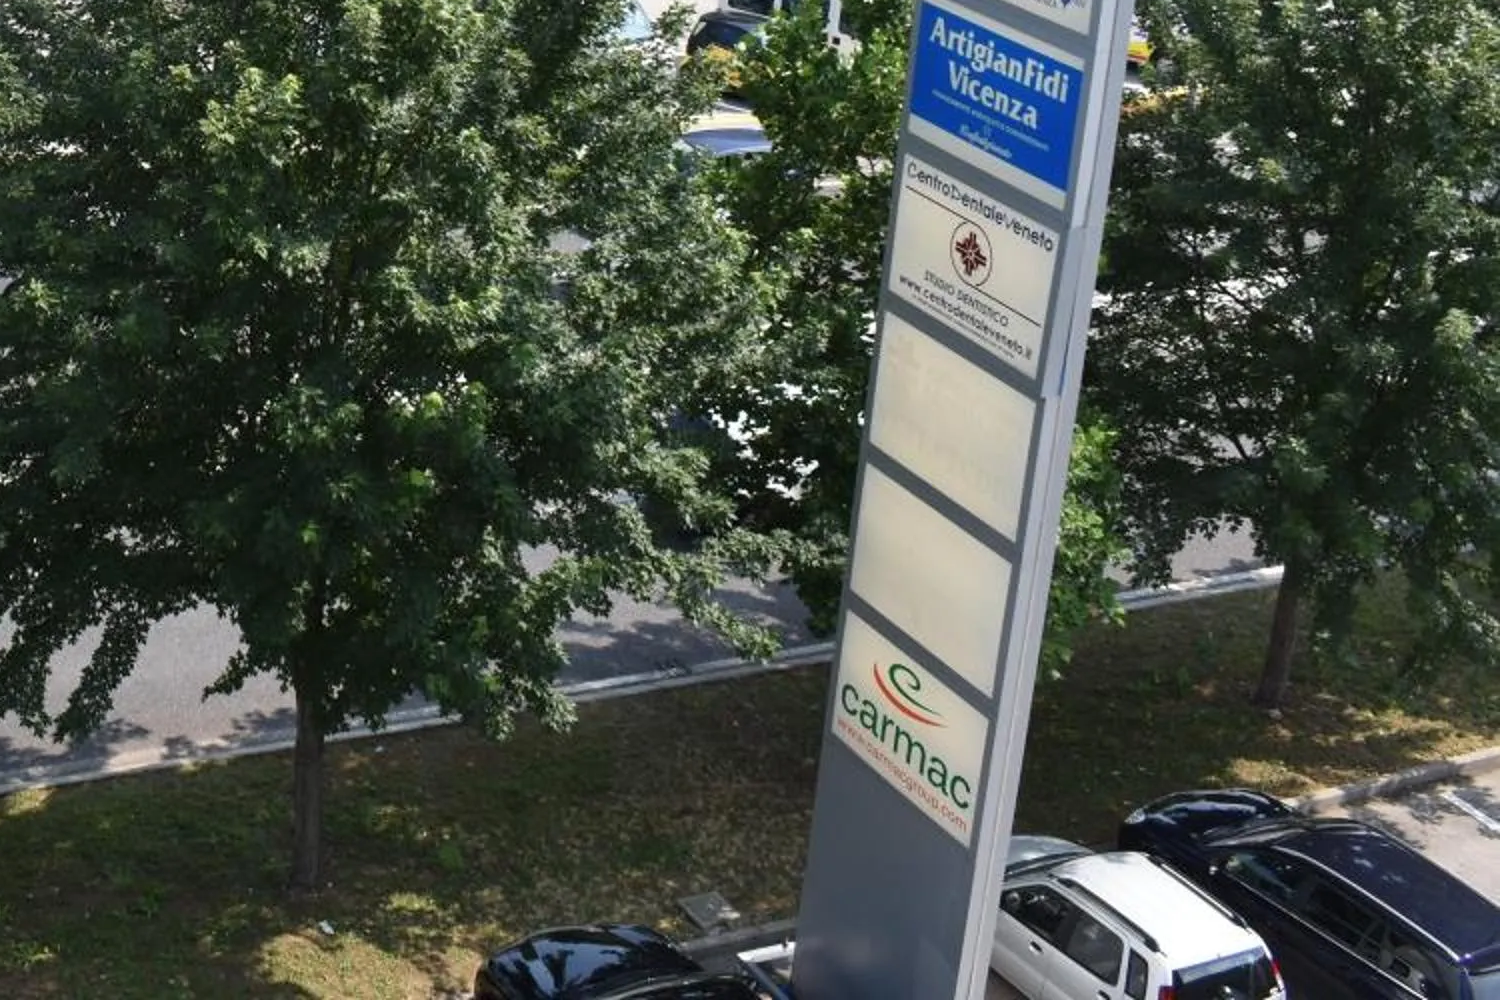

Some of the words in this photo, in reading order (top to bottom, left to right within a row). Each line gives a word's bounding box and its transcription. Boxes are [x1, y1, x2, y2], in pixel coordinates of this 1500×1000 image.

[928, 14, 1069, 104] ArtigianFidi
[948, 60, 1038, 130] Vicenza
[924, 269, 955, 295] STUDIO
[841, 683, 971, 810] carmac
